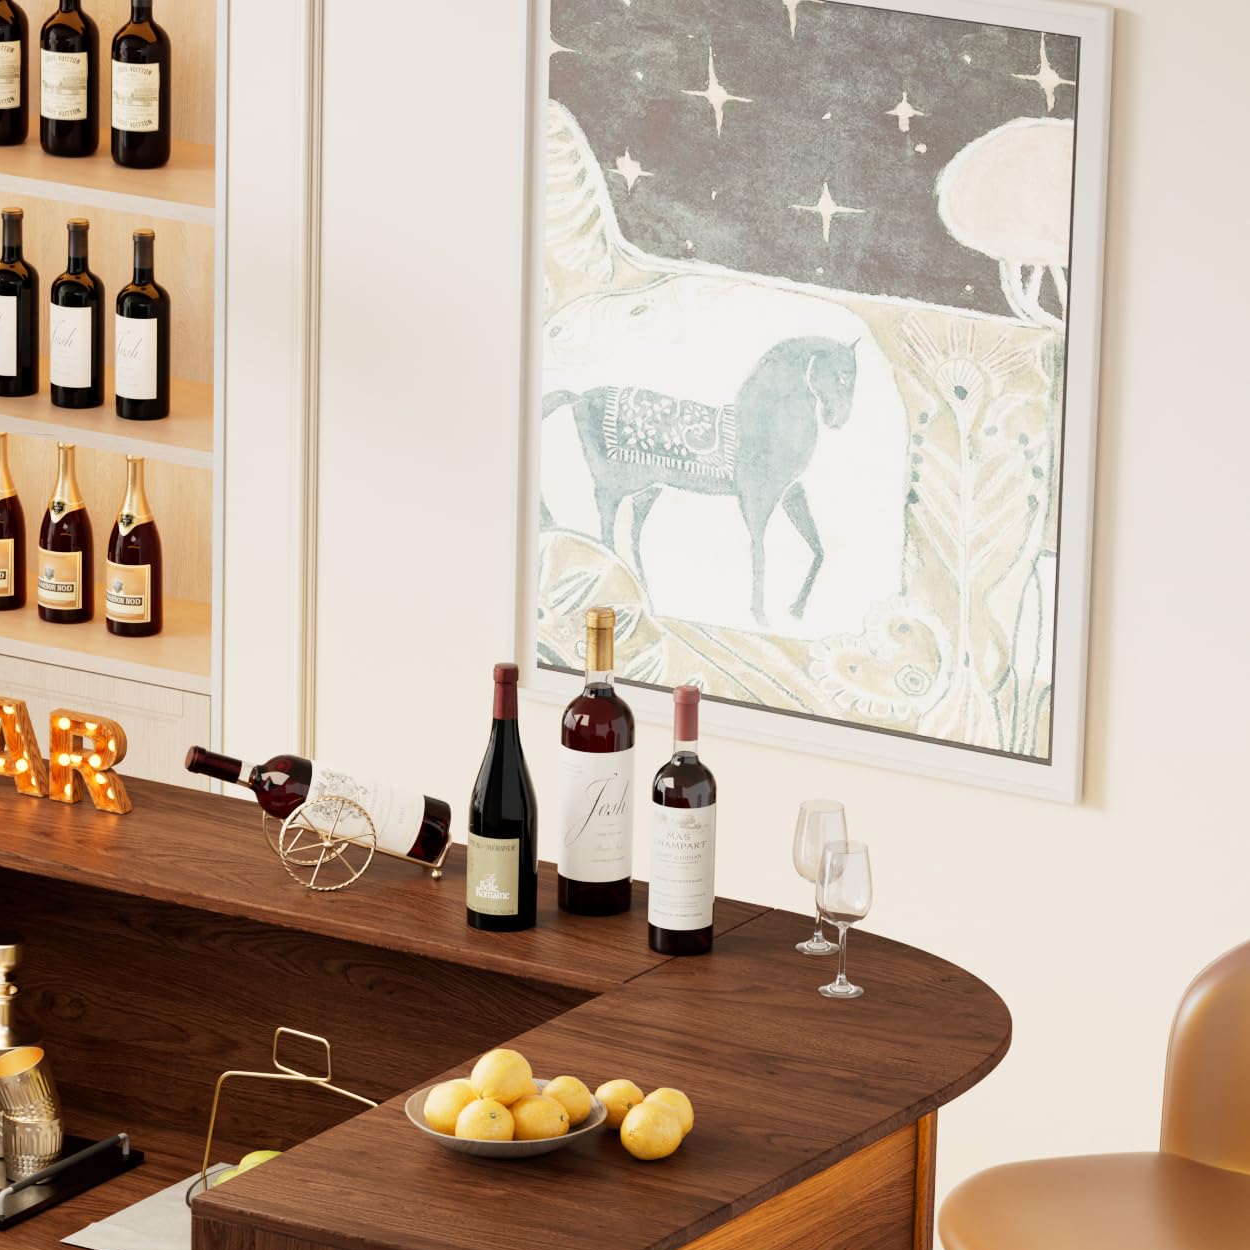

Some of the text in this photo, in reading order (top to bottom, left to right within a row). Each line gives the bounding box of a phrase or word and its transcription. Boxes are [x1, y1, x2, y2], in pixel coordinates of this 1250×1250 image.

[57, 584, 73, 592] NOD
[125, 597, 141, 605] NOD
[565, 770, 630, 848] Josh
[666, 831, 692, 841] MAS
[475, 886, 510, 899] Romaine
